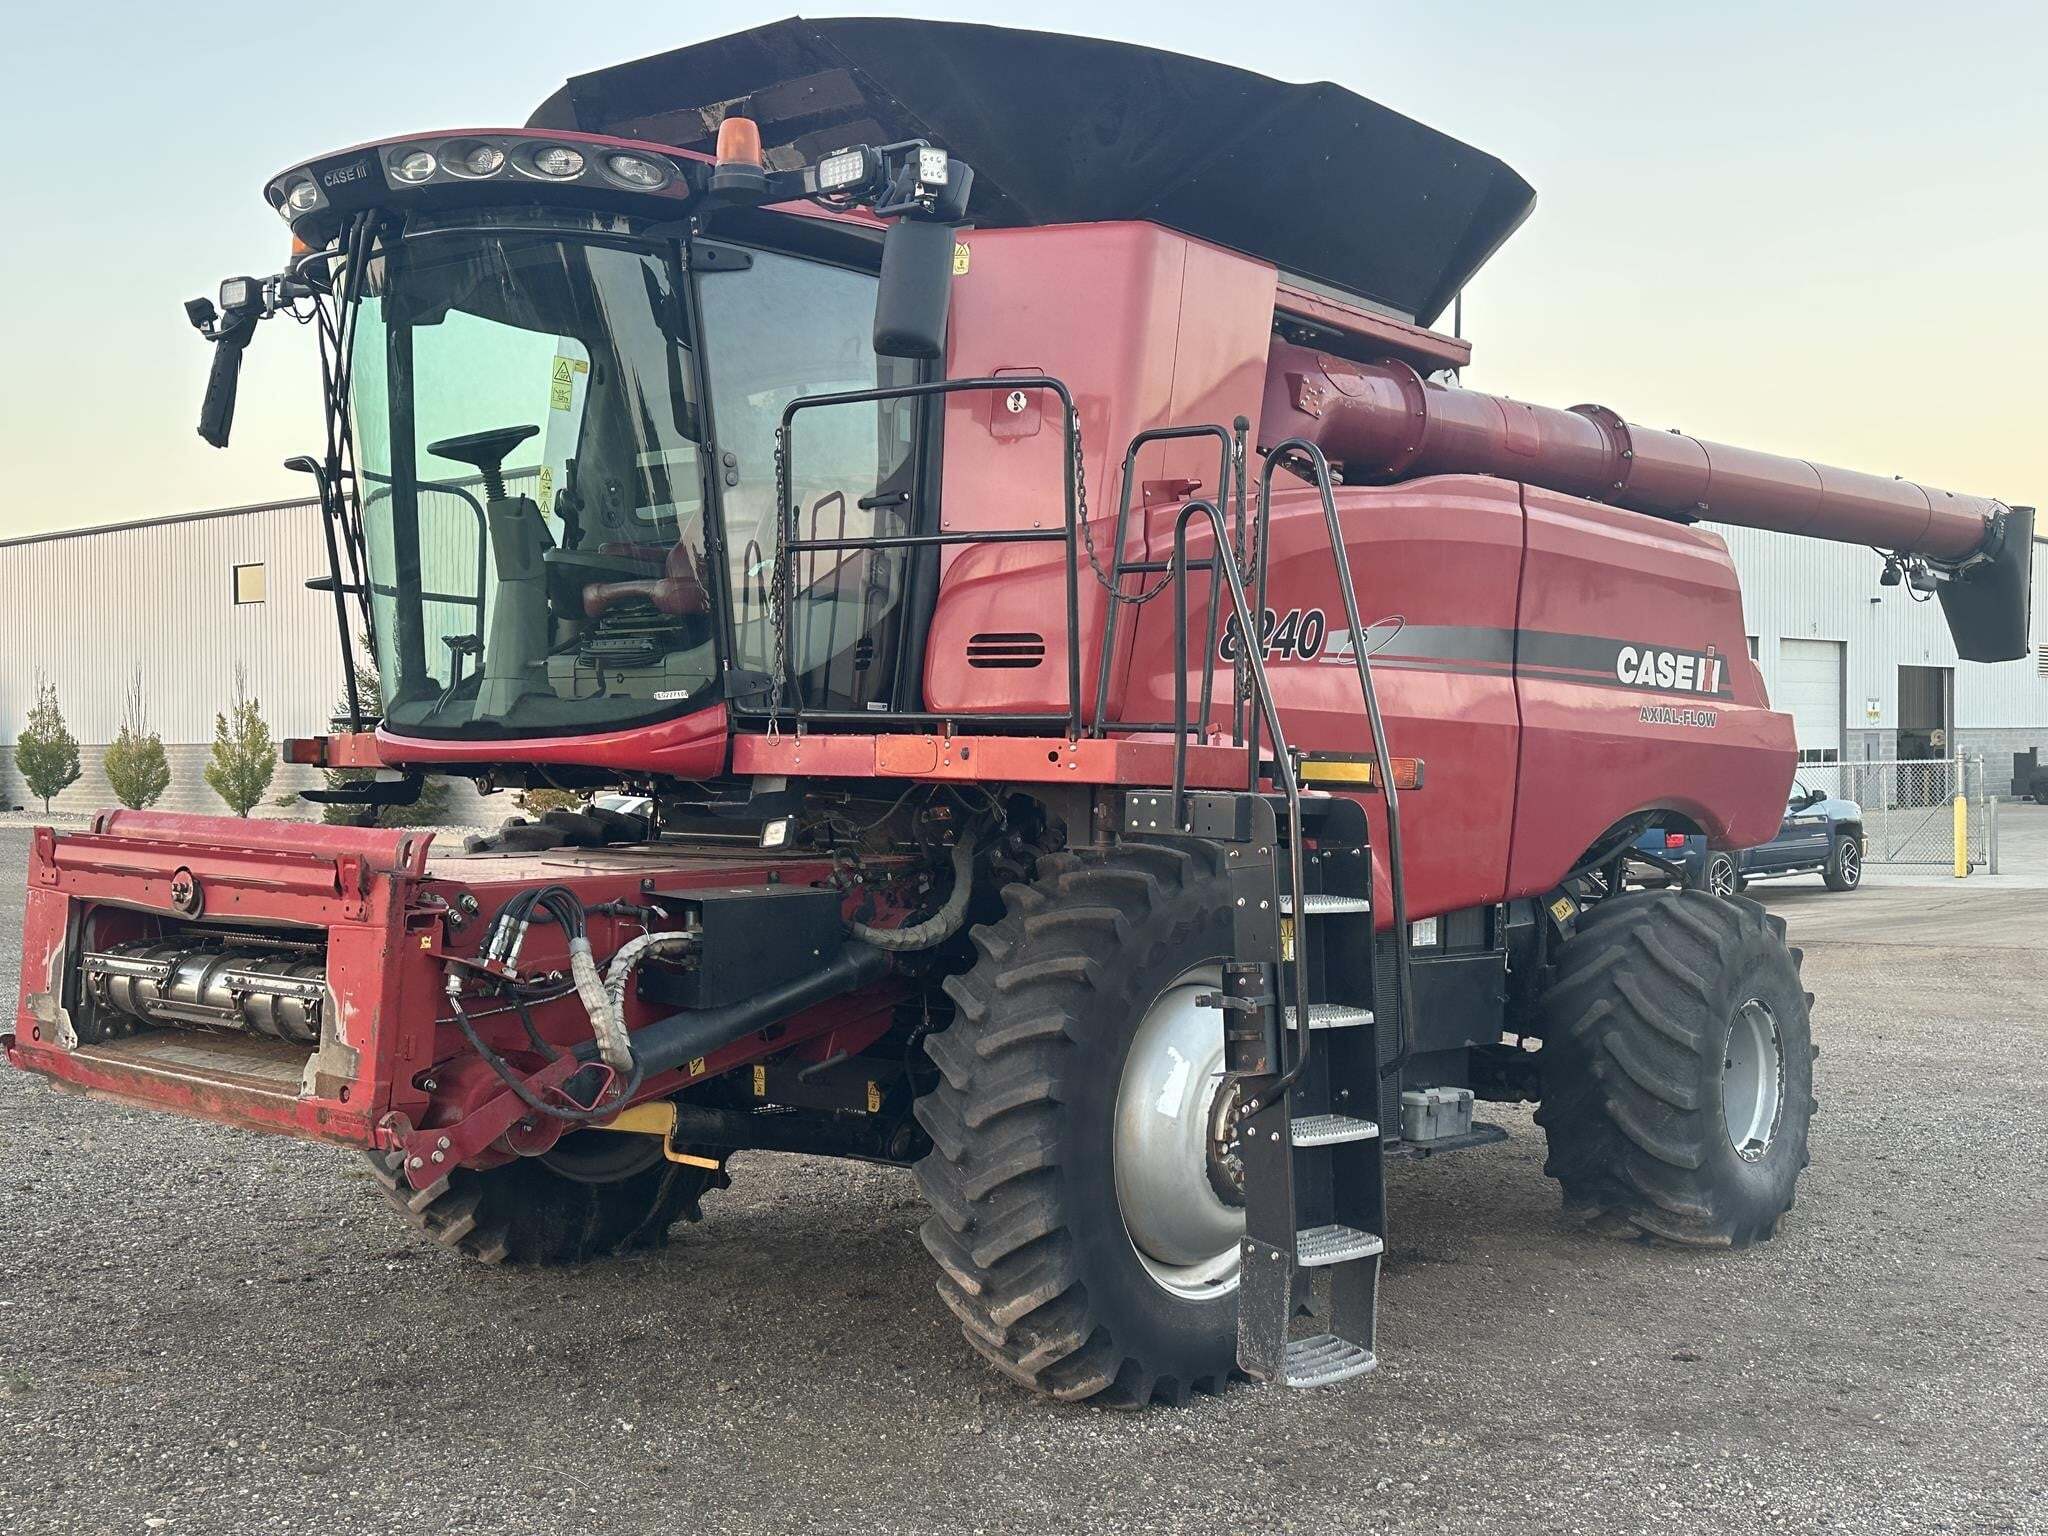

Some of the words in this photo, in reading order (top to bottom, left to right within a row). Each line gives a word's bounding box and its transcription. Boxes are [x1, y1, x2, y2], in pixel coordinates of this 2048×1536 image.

[324, 169, 355, 187] CASE
[1616, 646, 1695, 690] CASE
[1639, 705, 1718, 728] AXIAL-FLOW
